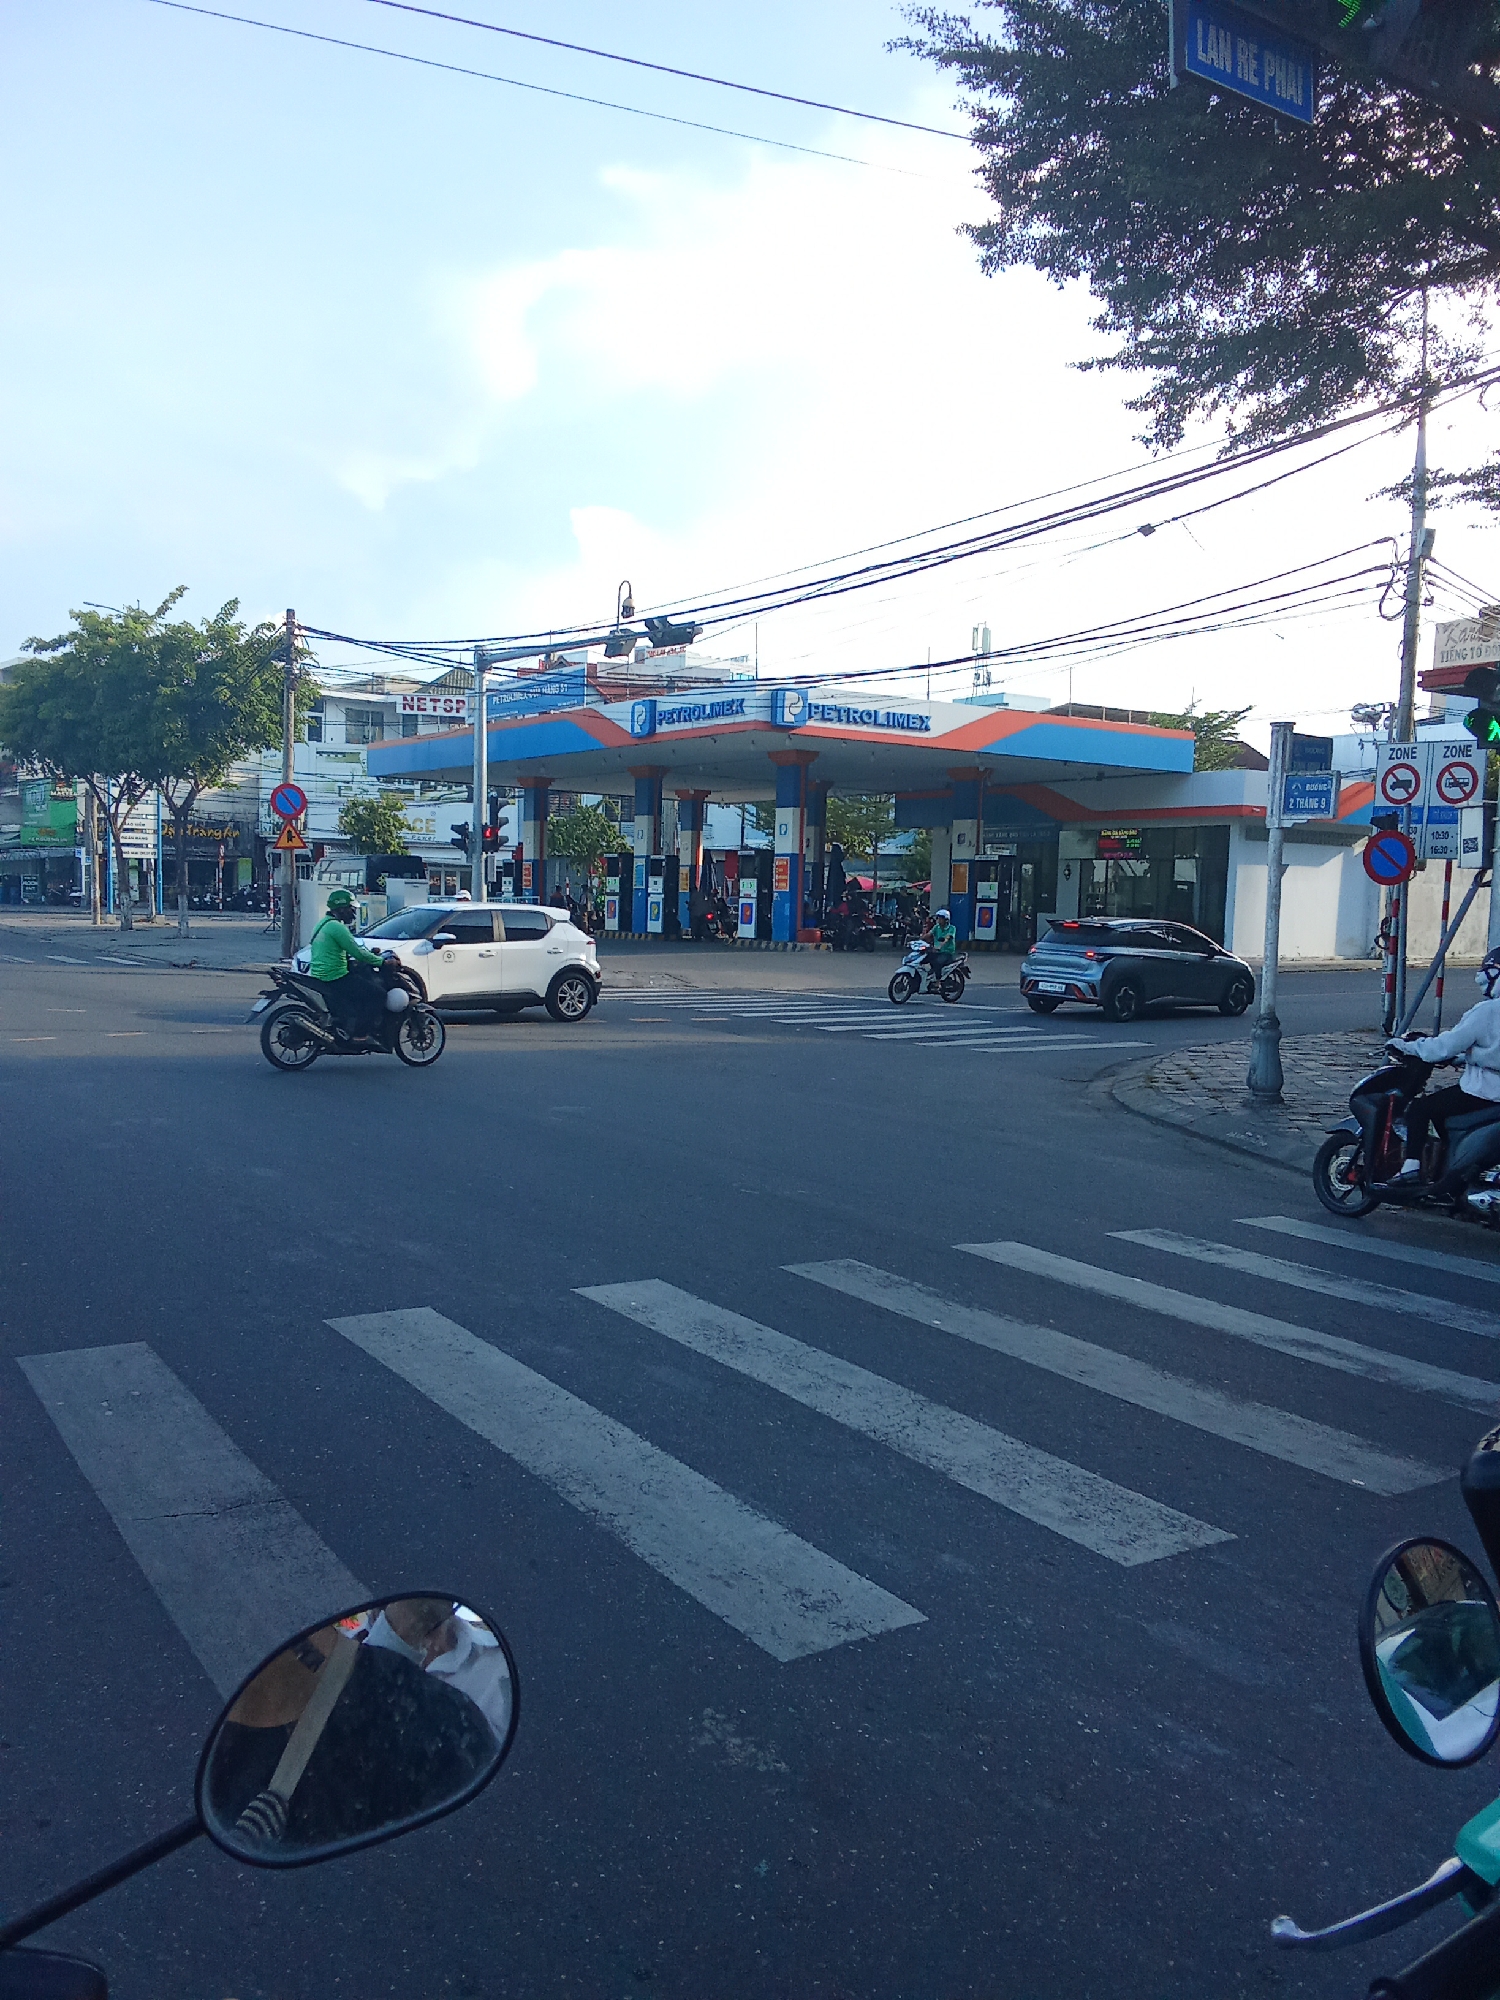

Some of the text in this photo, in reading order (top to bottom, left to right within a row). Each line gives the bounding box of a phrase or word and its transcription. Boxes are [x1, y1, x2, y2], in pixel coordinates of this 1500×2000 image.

[656, 698, 745, 726] PETROLIMEX
[808, 702, 932, 731] PETROLIMEX
[1388, 747, 1418, 760] ZONE
[1443, 744, 1473, 758] ZONE
[1289, 796, 1326, 809] 2 THÁNG 9
[1430, 846, 1448, 855] 16:30
